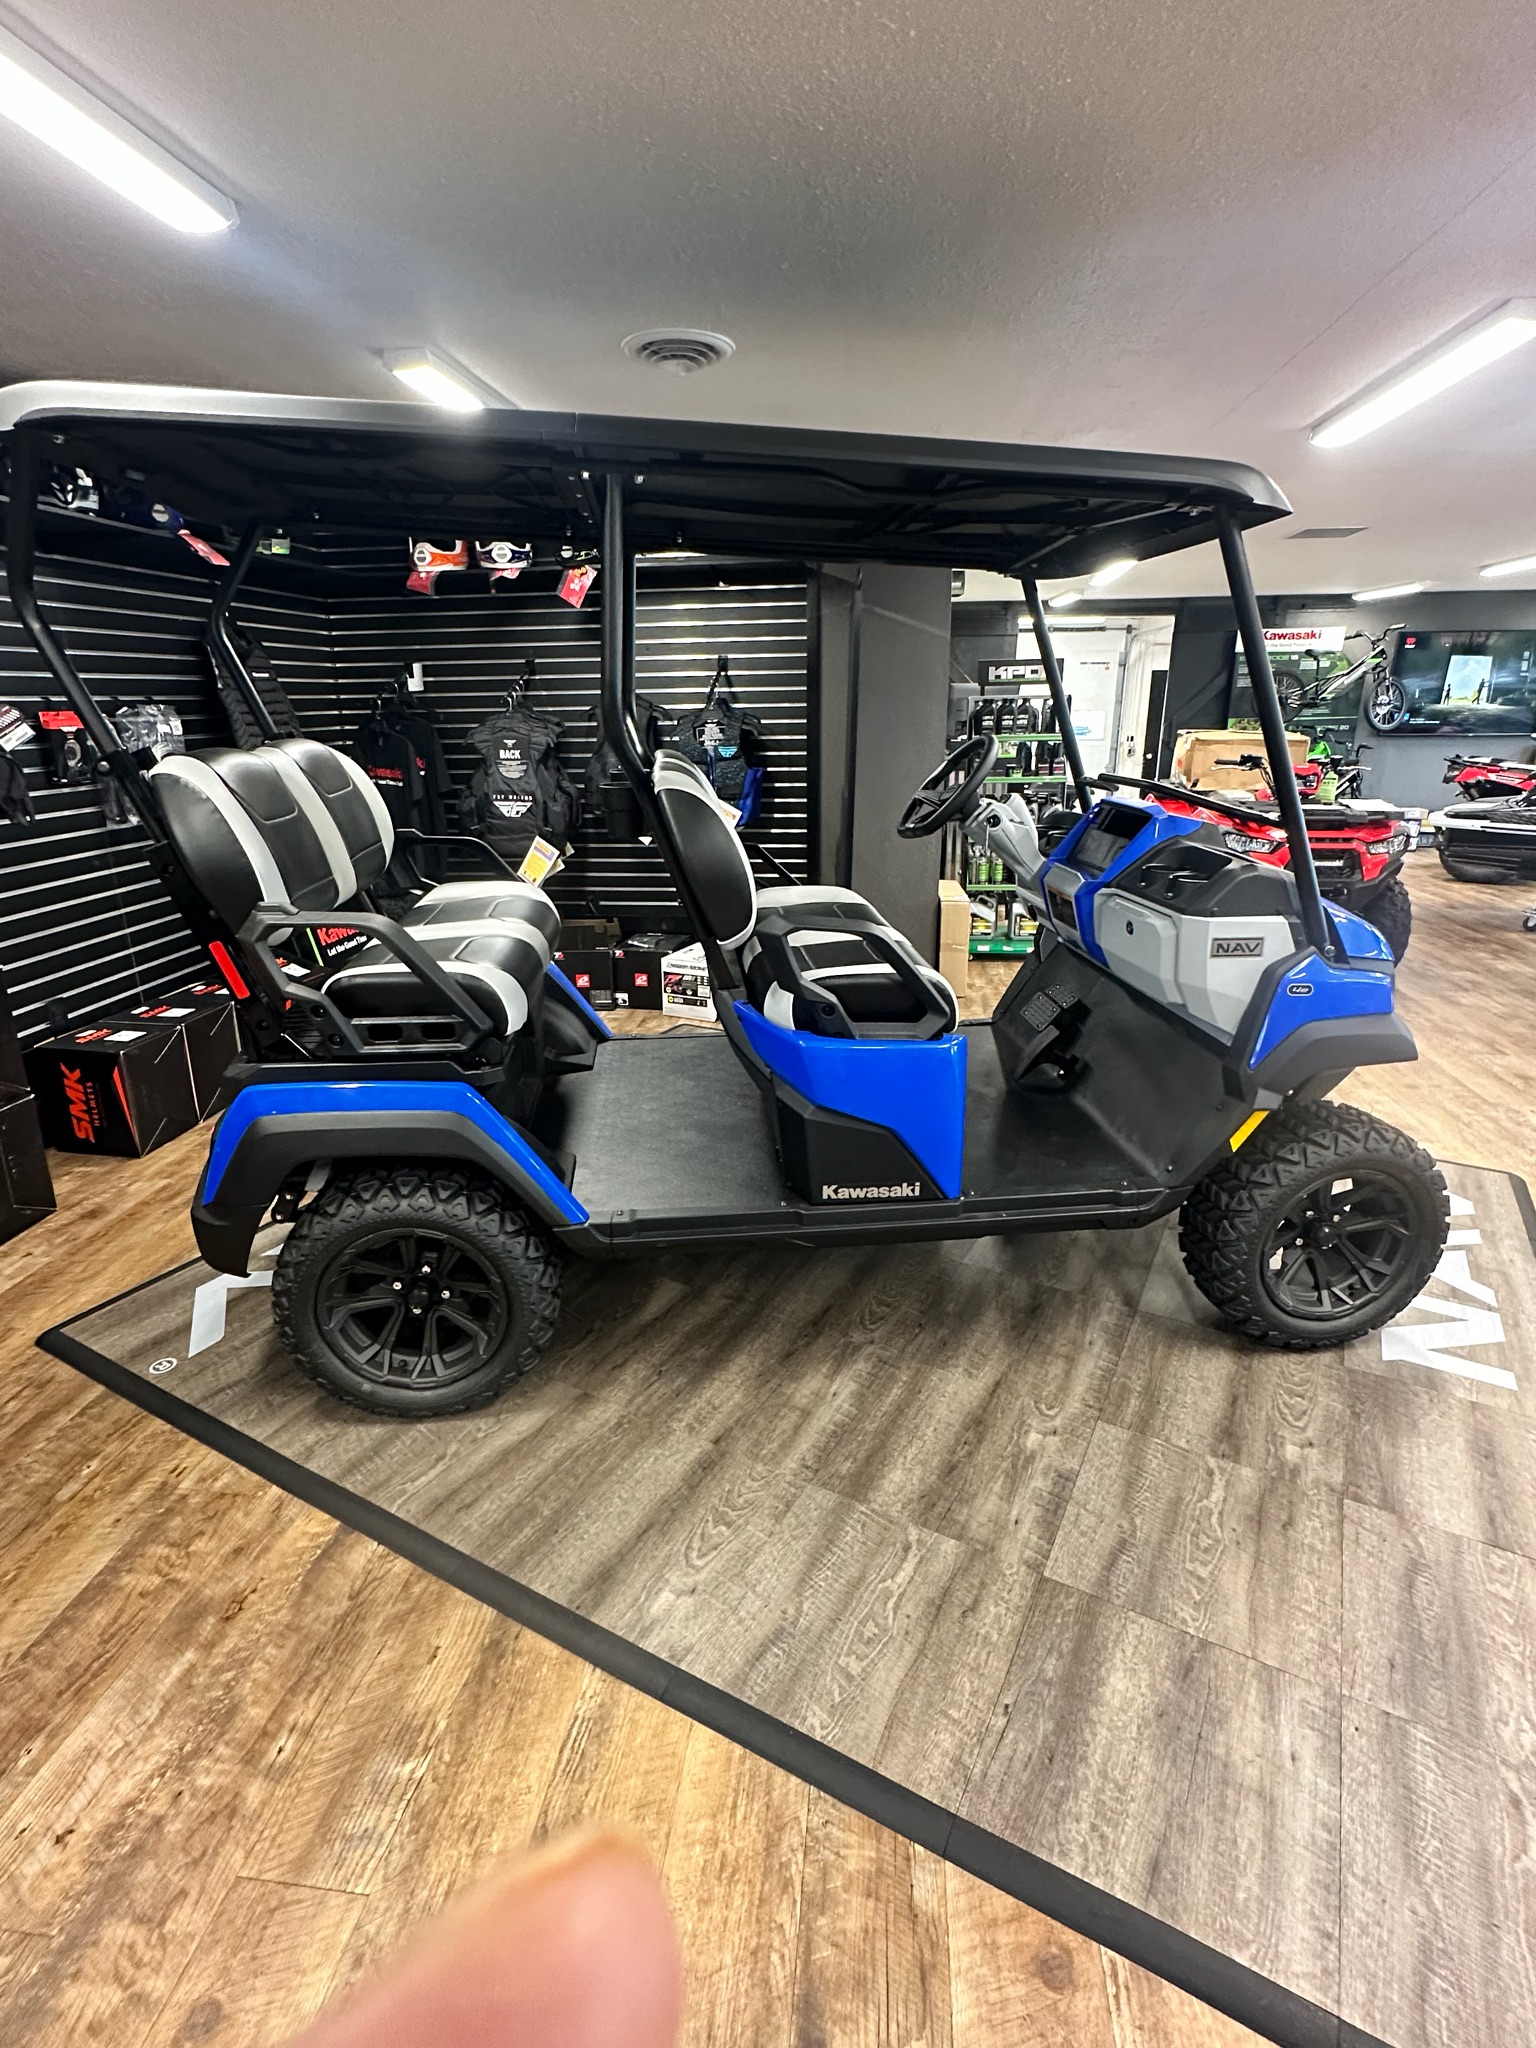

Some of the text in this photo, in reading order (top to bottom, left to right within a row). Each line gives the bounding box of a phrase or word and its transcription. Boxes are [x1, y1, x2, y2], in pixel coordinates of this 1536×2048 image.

[1263, 630, 1322, 640] Kawasaki
[499, 749, 521, 759] BACK
[1216, 943, 1260, 953] NAV
[60, 1062, 95, 1143] SMK
[86, 1082, 100, 1126] HELMETS
[822, 1182, 920, 1199] Kawasaki
